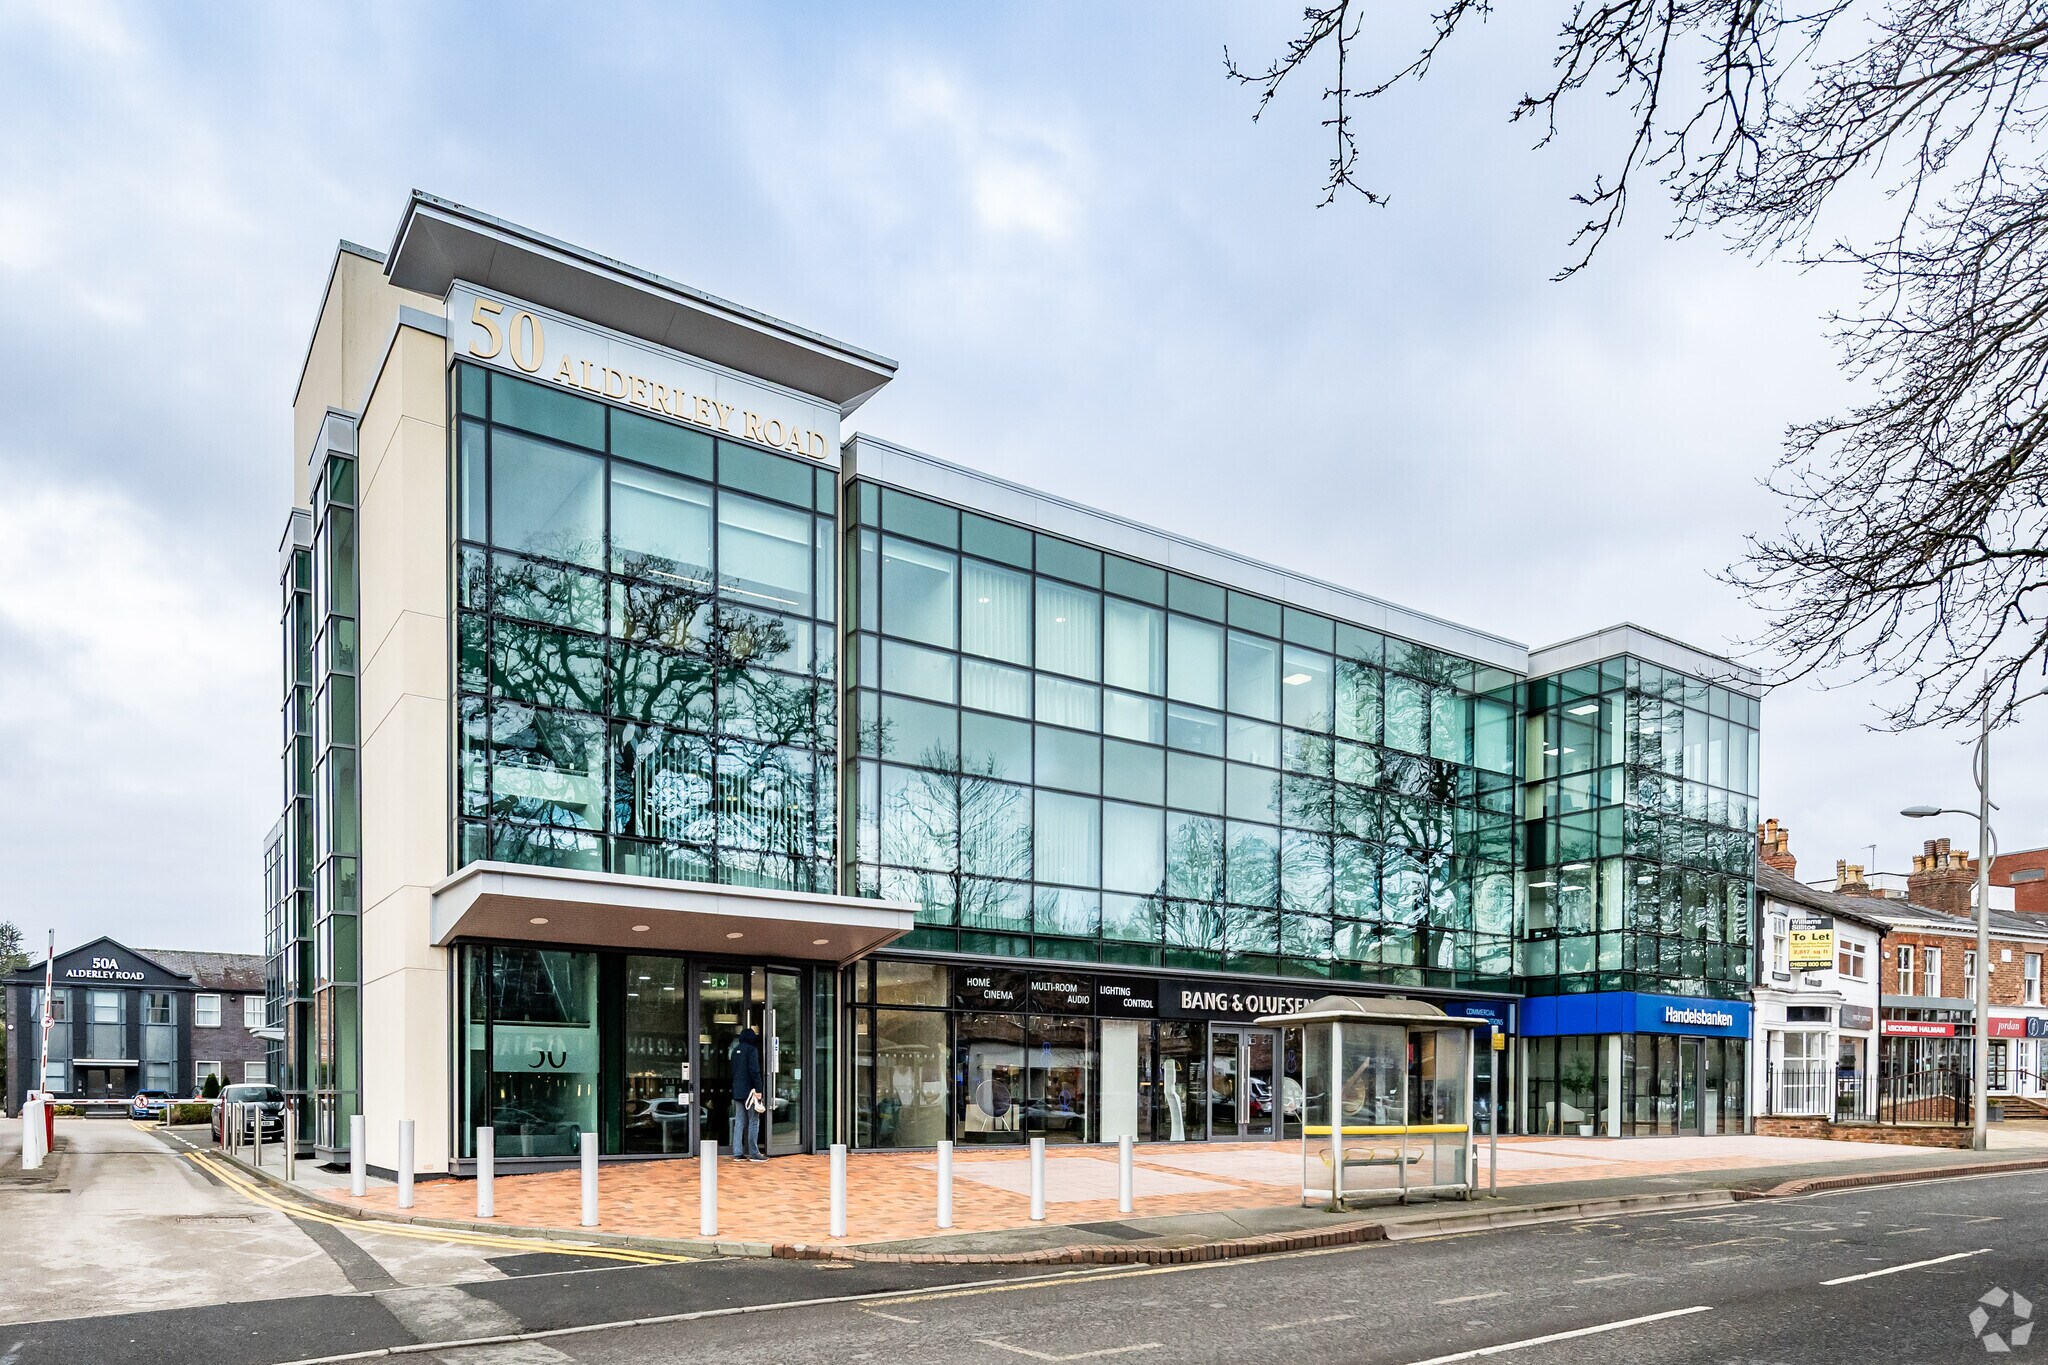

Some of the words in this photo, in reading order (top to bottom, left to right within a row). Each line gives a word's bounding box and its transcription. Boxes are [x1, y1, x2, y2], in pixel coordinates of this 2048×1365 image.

[468, 296, 545, 374] 50
[553, 354, 735, 434] ALDERLEY
[742, 410, 831, 461] ROAD
[91, 957, 119, 970] 50A
[65, 968, 115, 980] ALDERLEY
[116, 970, 145, 981] ROAD
[966, 977, 991, 988] HOME
[1031, 981, 1078, 993] MULTI-ROOM
[983, 989, 1014, 1000] CINEMA
[1100, 985, 1131, 996] LIGHTING
[1067, 995, 1090, 1004] AUDIO
[1123, 997, 1154, 1009] CONTROL
[1181, 990, 1228, 1011] BANG
[1231, 994, 1243, 1012] &
[1466, 1007, 1496, 1016] COMMERCIAL
[1665, 1006, 1733, 1027] Handelsbanken
[1996, 1020, 2020, 1035] jordan
[527, 1037, 567, 1068] 50
